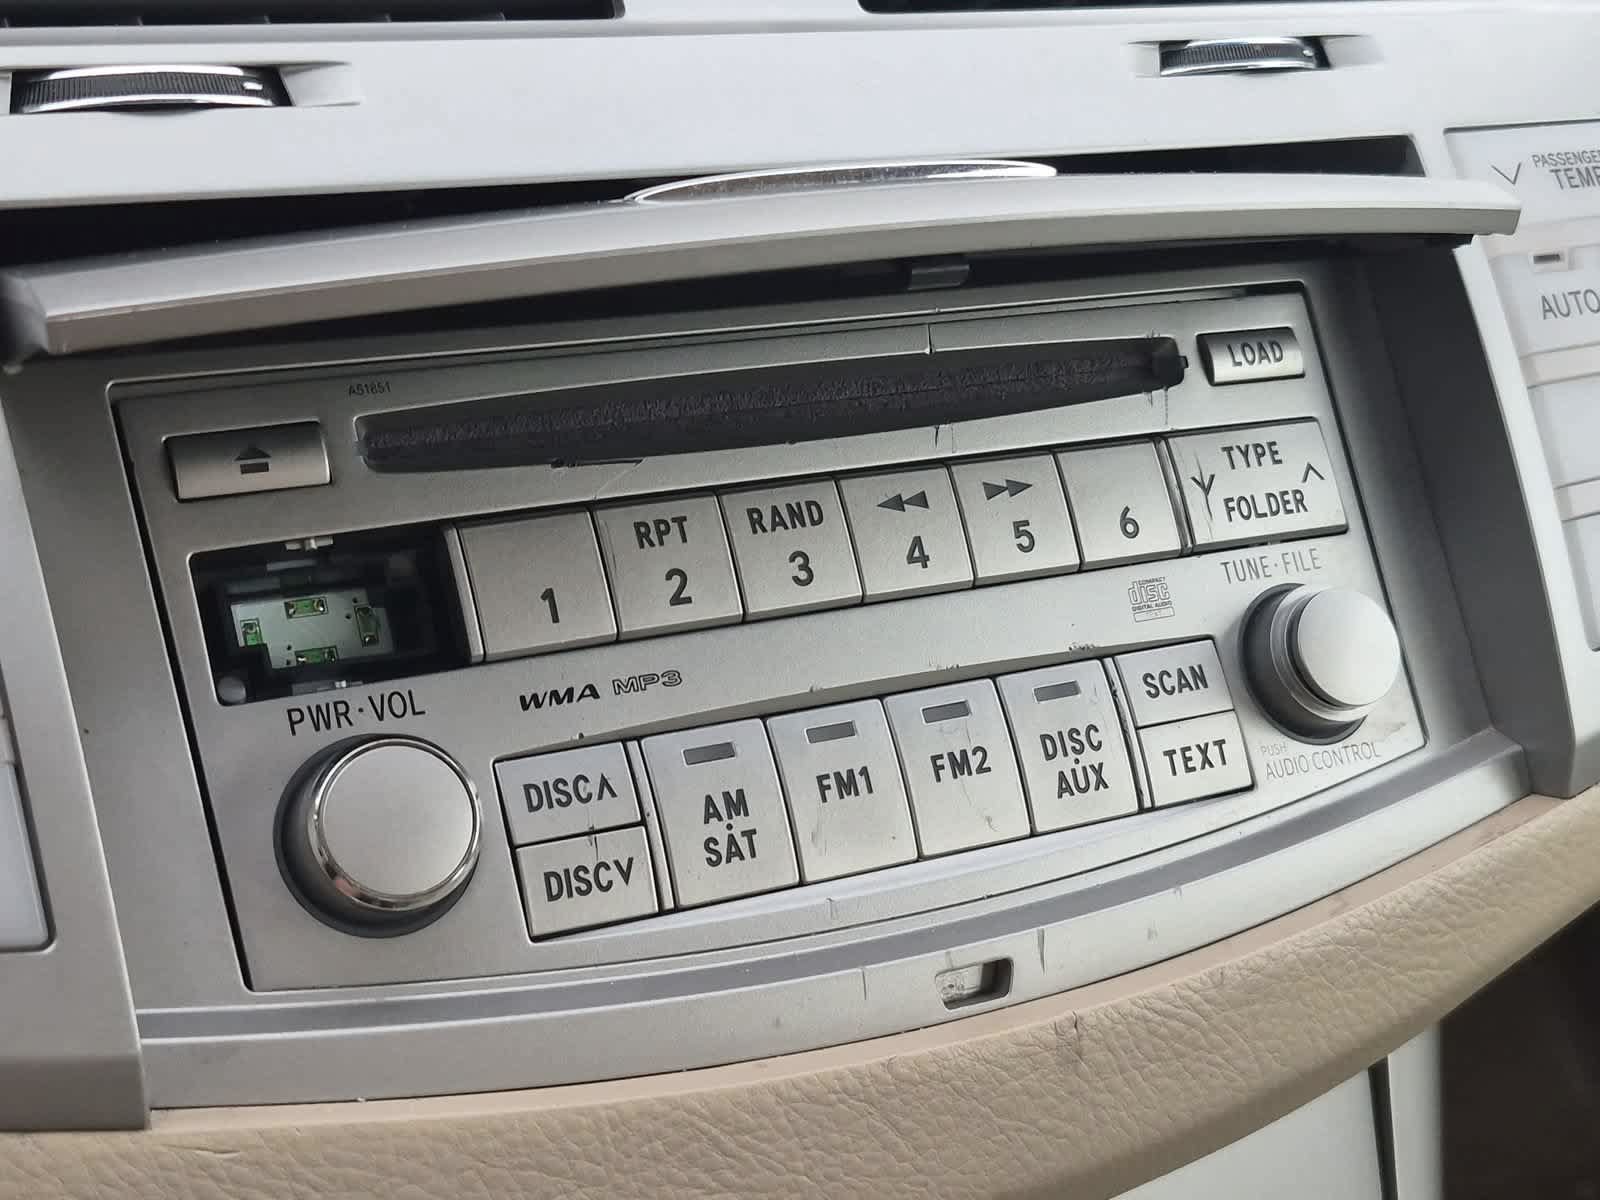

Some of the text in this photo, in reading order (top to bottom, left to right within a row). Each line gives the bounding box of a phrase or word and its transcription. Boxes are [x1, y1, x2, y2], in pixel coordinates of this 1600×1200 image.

[1531, 149, 1600, 168] PASSENGE
[1541, 288, 1600, 320] AUTO
[1227, 339, 1284, 367] LOAD
[1220, 440, 1283, 470] TYPE
[746, 500, 825, 535] RAND
[1119, 505, 1140, 539] 6
[1223, 488, 1309, 522] FOLDER
[633, 515, 689, 549] RPT
[1012, 519, 1036, 553] 5
[788, 550, 815, 587] 3
[905, 535, 931, 569] 4
[664, 567, 693, 607] 2
[540, 587, 561, 624] 1
[519, 669, 683, 712] WMA MP3
[1141, 663, 1209, 699] SCAN
[1039, 723, 1104, 762] DISC
[1163, 738, 1227, 777] TEXT
[1260, 741, 1288, 757] PUSH
[1265, 741, 1382, 780] AUDIO CONTROL
[930, 746, 992, 783] FM2
[1056, 761, 1110, 799] AUX
[815, 765, 874, 803] FM1
[703, 788, 750, 824] AM
[704, 828, 758, 868] SAT
